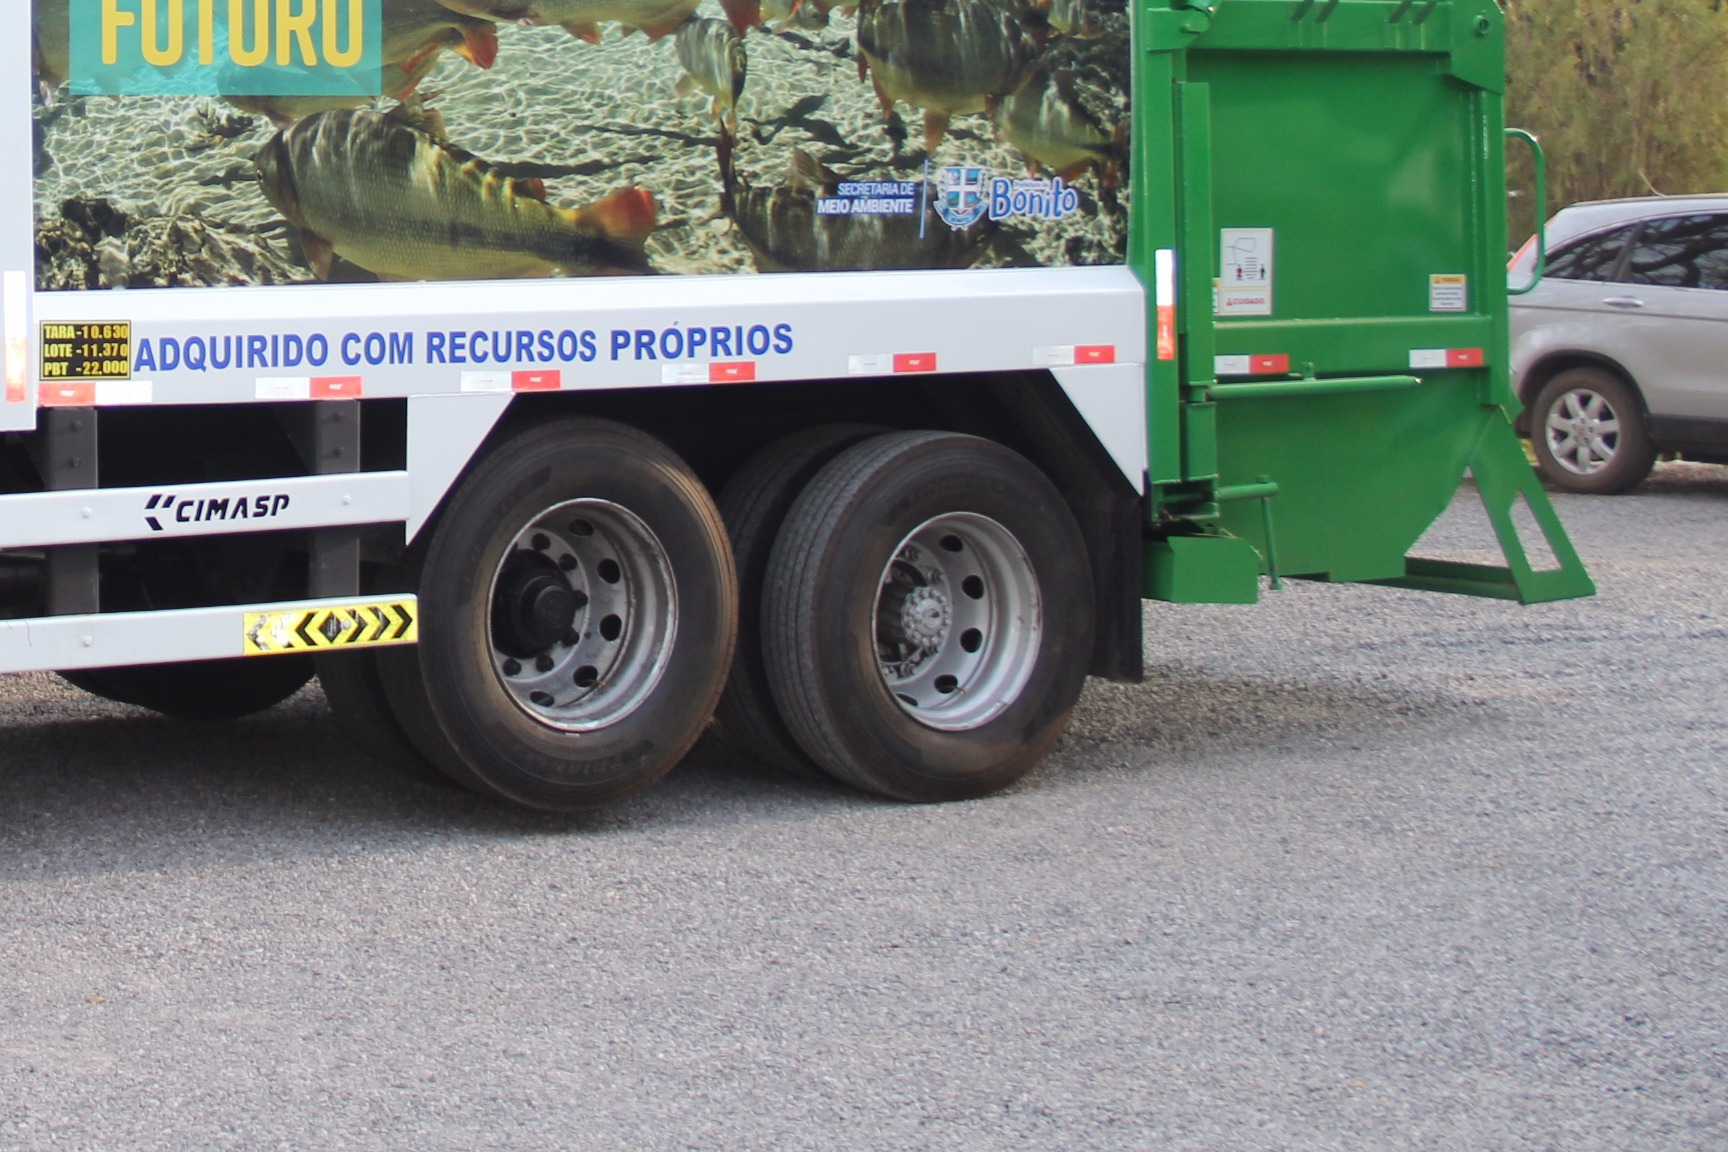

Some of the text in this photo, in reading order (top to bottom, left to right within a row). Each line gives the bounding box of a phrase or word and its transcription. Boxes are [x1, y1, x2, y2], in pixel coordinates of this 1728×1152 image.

[837, 182, 915, 196] SECRETARIA DE
[990, 177, 1078, 219] Bonito
[817, 198, 914, 214] MEIO AMBIENTE
[45, 325, 76, 339] TARA
[45, 343, 73, 358] LOTE
[133, 322, 794, 371] ADQUIRIDO COM RECURSOS PRÓPRIOS
[45, 361, 69, 376] PBT
[176, 494, 290, 523] CIMASP
